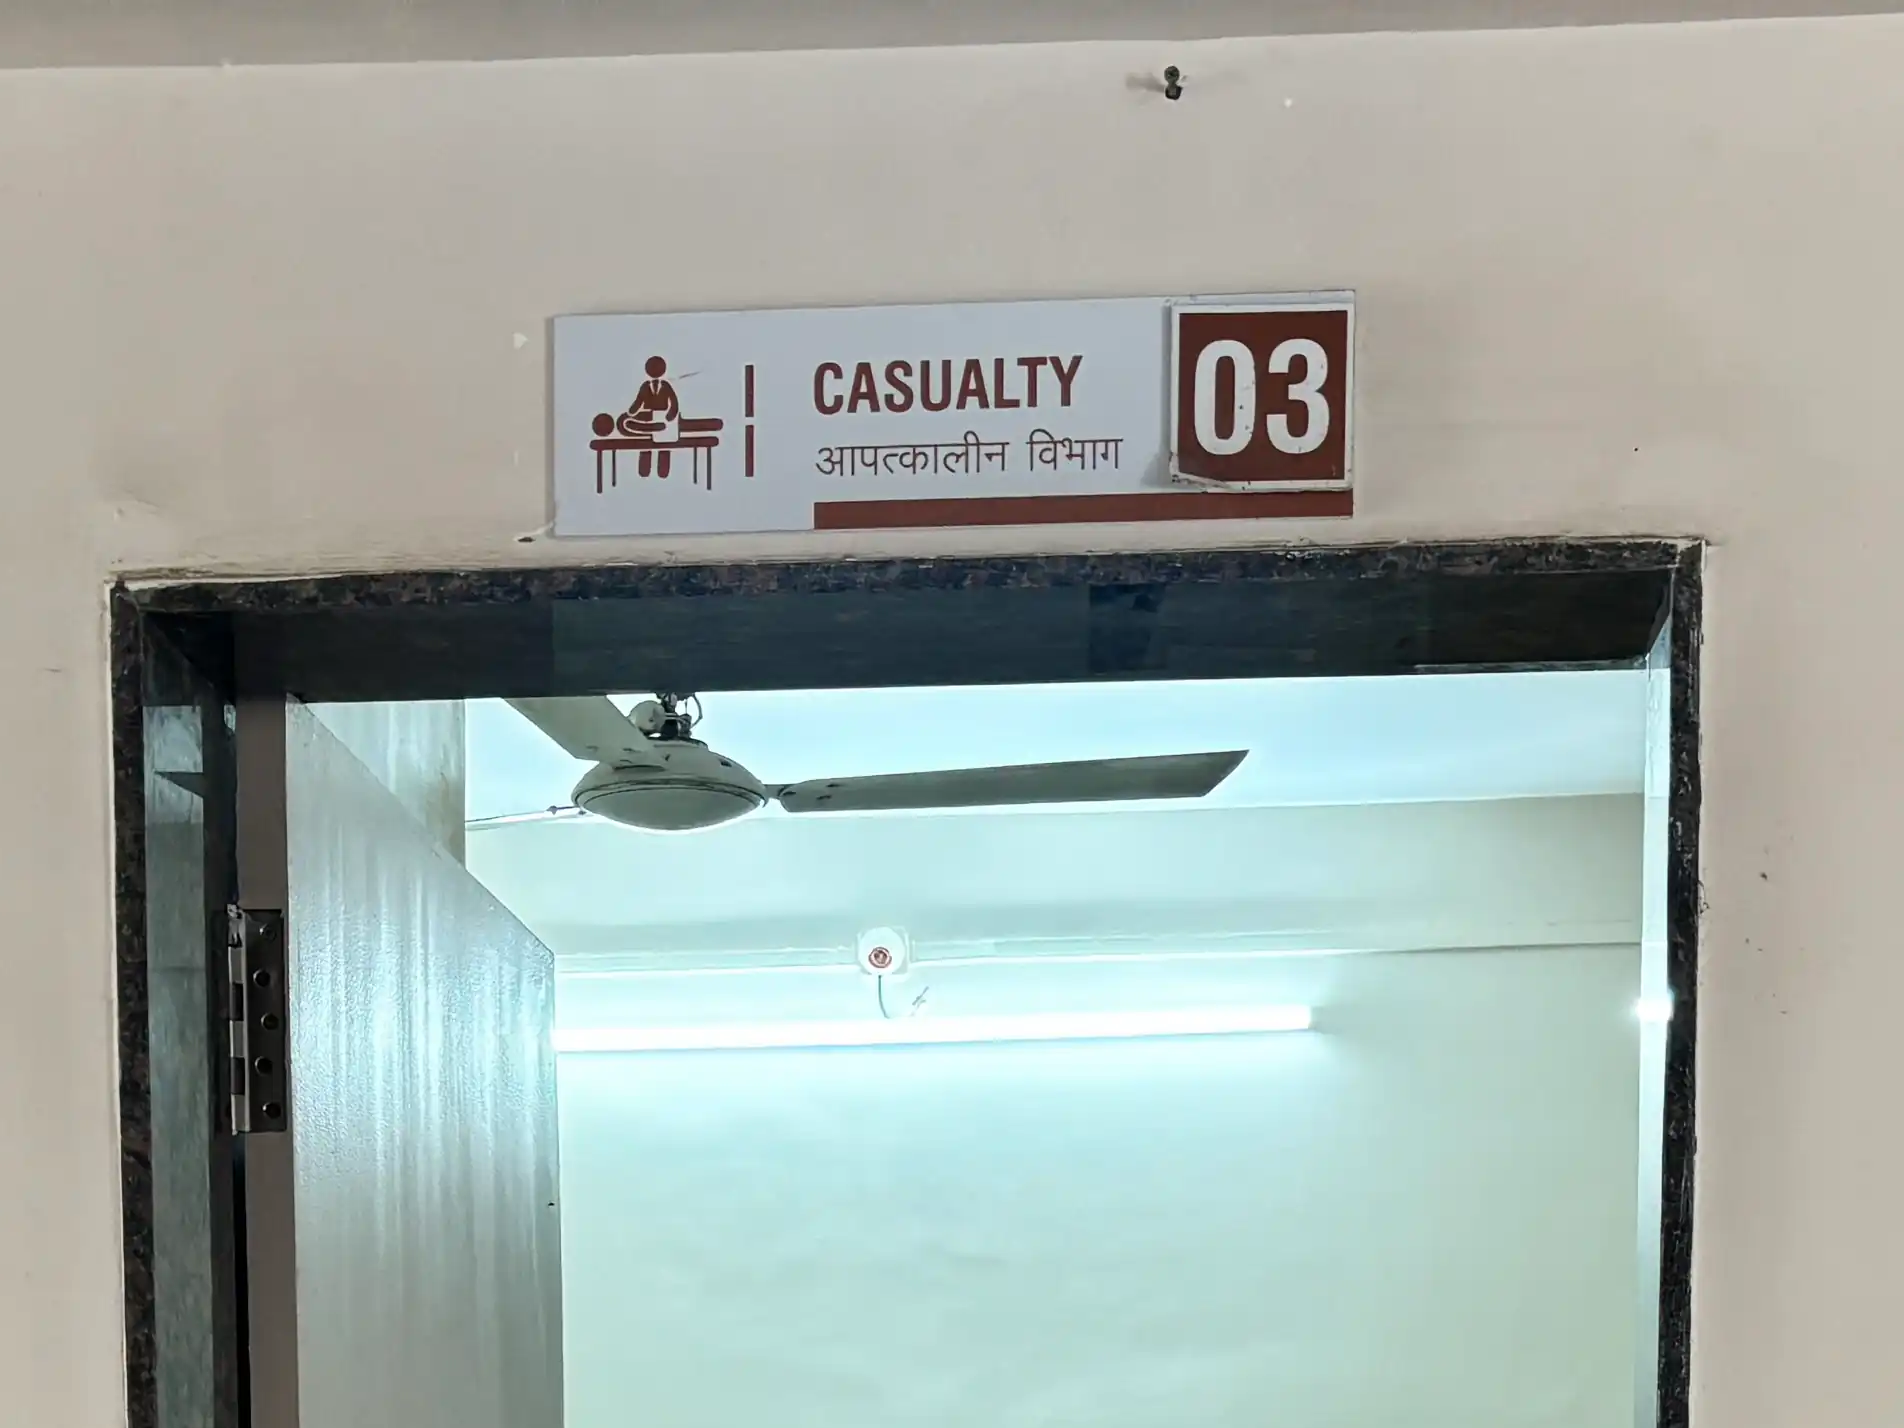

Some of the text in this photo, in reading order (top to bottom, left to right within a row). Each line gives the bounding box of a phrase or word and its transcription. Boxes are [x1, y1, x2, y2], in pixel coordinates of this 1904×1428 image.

[814, 355, 1083, 415] CASUALTY
[1194, 338, 1330, 455] 03
[815, 428, 1124, 476] आपत्कालीन विभाग
